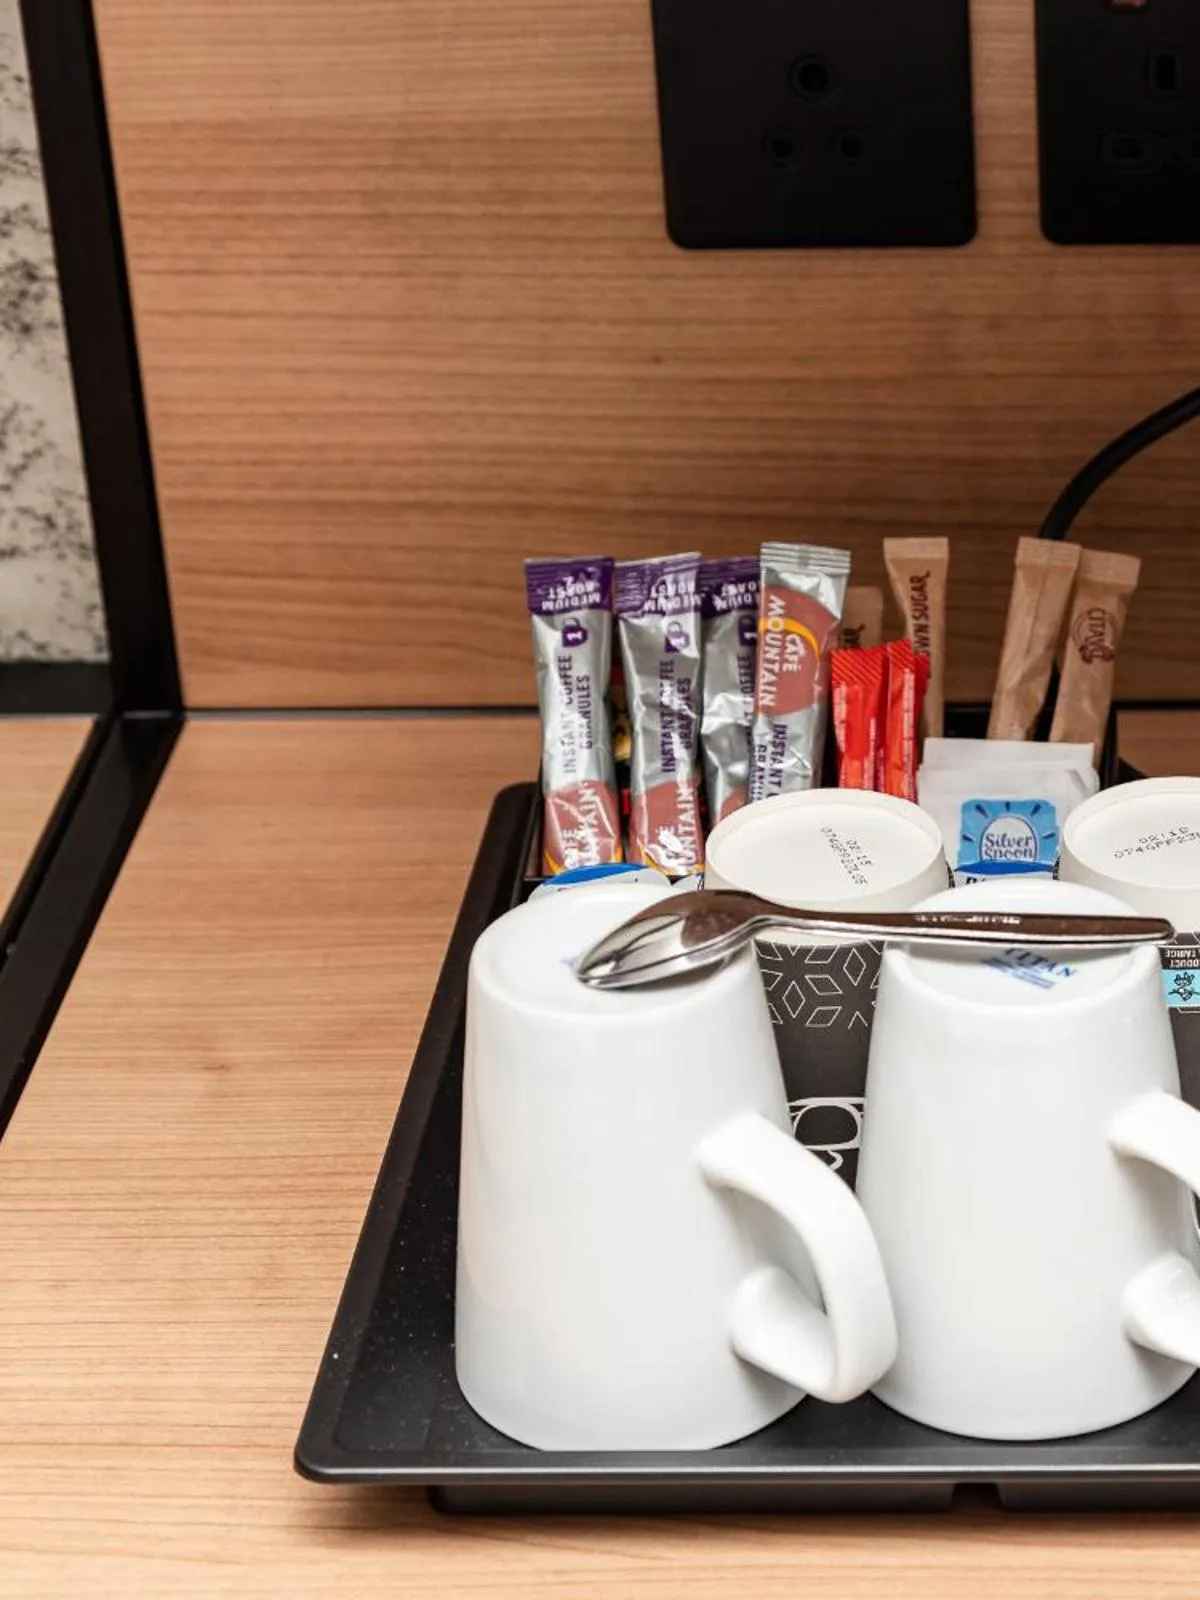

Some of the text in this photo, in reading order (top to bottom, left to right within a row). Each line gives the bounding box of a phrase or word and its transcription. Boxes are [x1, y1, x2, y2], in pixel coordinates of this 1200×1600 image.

[541, 591, 601, 612] MEDIUM
[547, 580, 598, 600] ROAST
[720, 579, 761, 598] OAST
[910, 571, 931, 621] SUGAR
[758, 594, 787, 707] MOUNTAIN
[782, 633, 805, 673] CAFÉ
[660, 660, 676, 772] INSTANT CFEE
[559, 710, 577, 774] INSTANT
[768, 724, 788, 788] INSTANT
[676, 786, 696, 869] UNTAIN
[984, 832, 1034, 849] Silver
[983, 846, 1034, 861] Spoon
